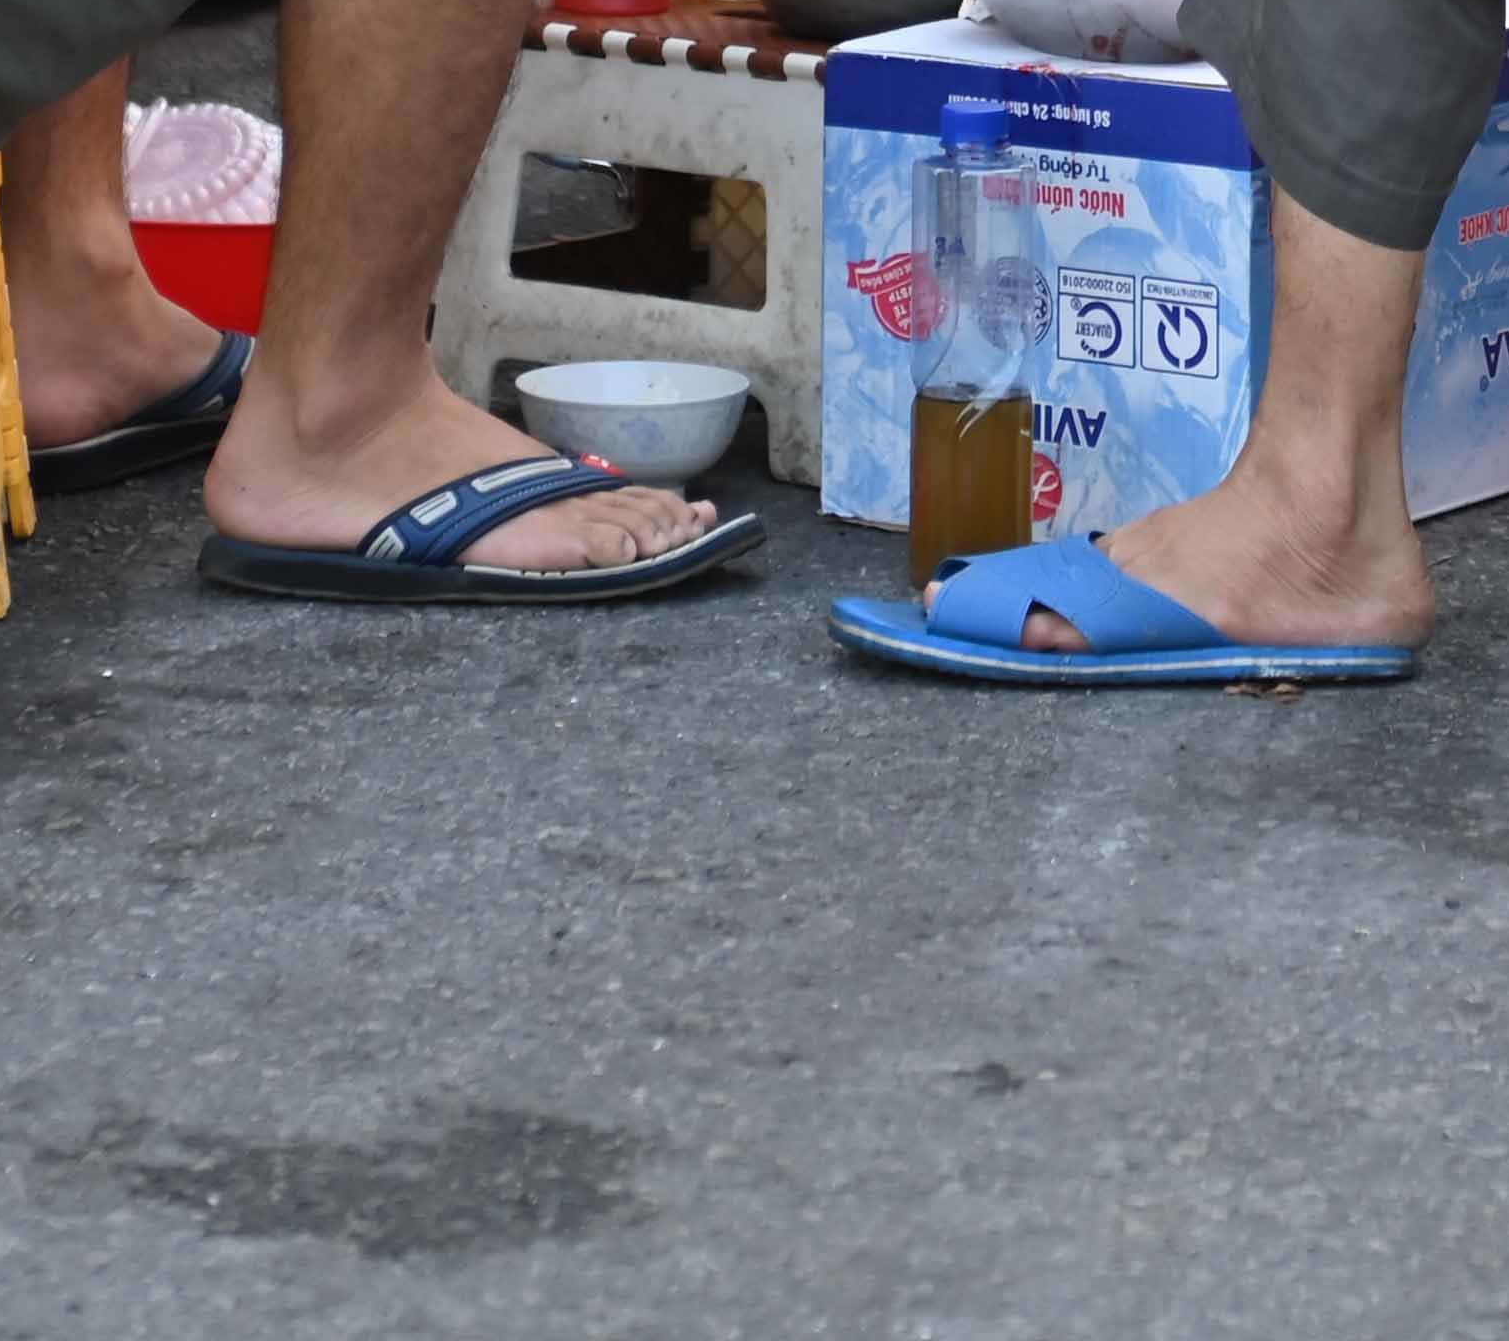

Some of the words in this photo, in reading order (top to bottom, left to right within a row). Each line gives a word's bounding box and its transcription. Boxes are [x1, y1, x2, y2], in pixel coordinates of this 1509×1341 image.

[1032, 103, 1049, 121] 24
[1038, 155, 1083, 180] động
[1084, 159, 1111, 183] Tự
[1079, 189, 1125, 219] Nước
[1115, 280, 1131, 295] ISO
[1075, 322, 1113, 339] QUACERT
